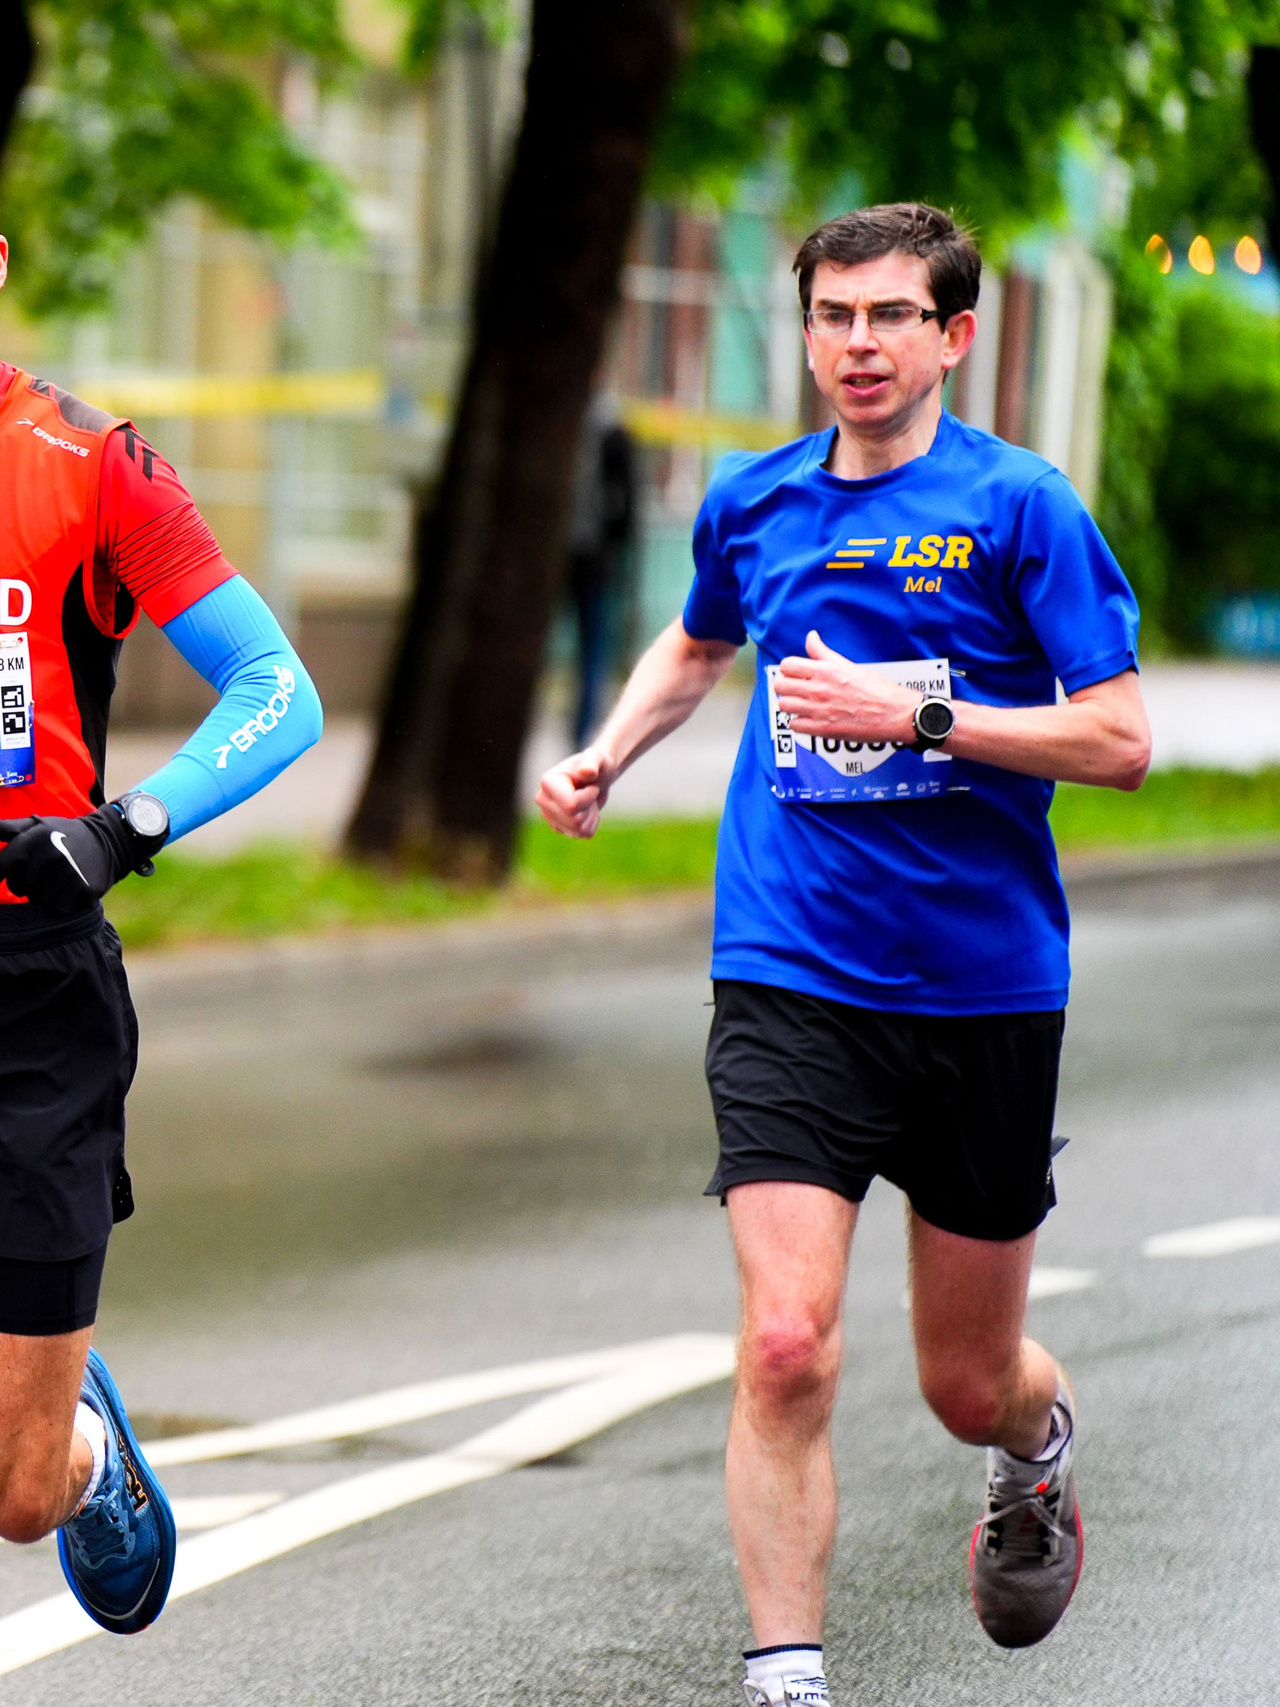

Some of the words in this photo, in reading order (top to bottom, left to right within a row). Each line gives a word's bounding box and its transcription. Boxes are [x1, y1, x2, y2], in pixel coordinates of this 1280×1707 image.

[32, 427, 90, 457] BROOKS
[887, 534, 974, 569] LSR
[904, 576, 942, 593] Mel
[7, 656, 25, 670] KM
[929, 679, 945, 691] KM
[229, 665, 295, 753] BROOKS
[846, 762, 866, 774] MEL
